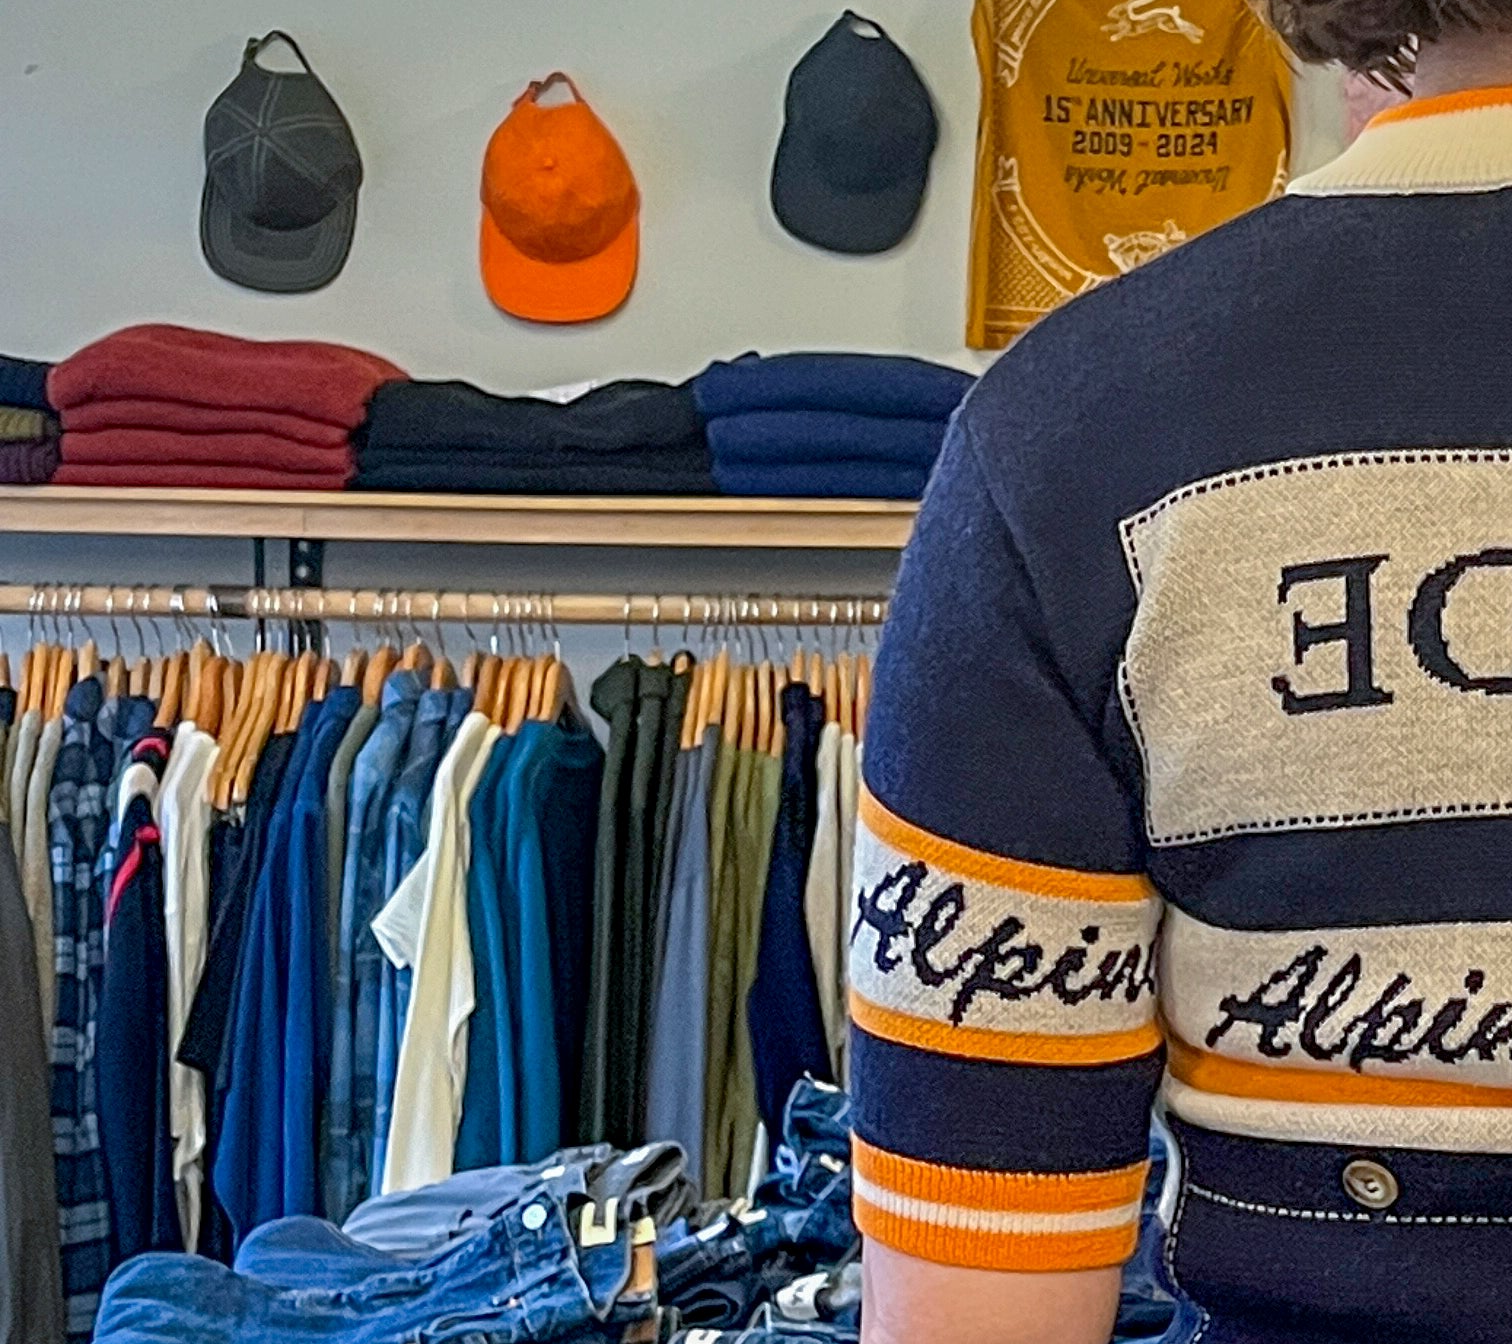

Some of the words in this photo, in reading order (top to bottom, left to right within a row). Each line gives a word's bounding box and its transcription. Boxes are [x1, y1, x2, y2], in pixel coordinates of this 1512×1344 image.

[1085, 96, 1254, 128] ANNIVERSARY
[1072, 130, 1133, 158] 2009
[1156, 131, 1218, 158] 2024
